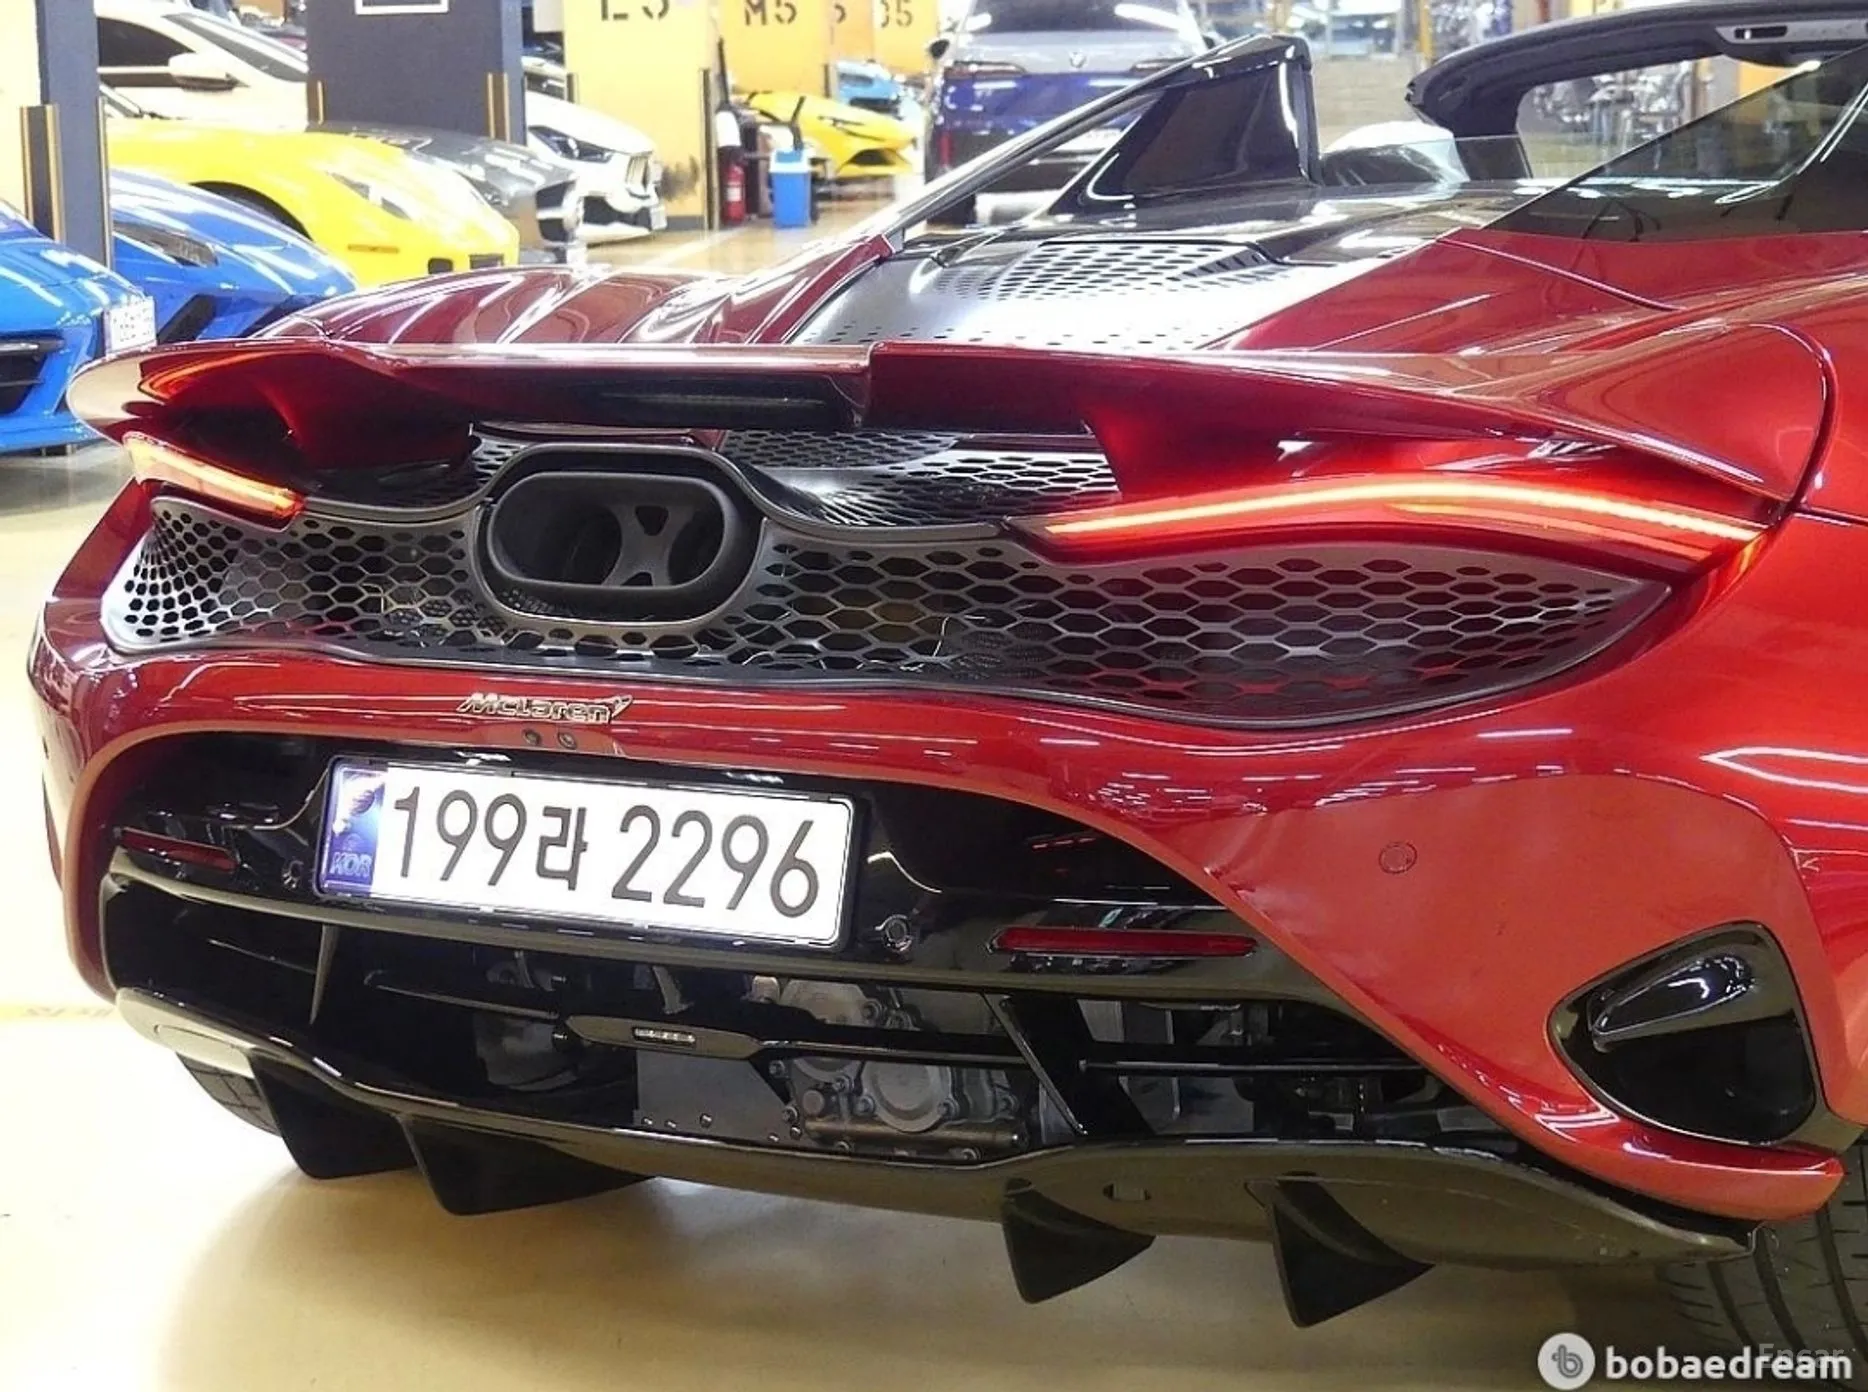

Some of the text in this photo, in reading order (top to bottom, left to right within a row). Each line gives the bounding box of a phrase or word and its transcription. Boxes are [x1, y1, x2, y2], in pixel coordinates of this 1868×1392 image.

[456, 692, 613, 724] McLaren
[329, 851, 373, 878] KOR
[394, 786, 820, 918] 199라 2296
